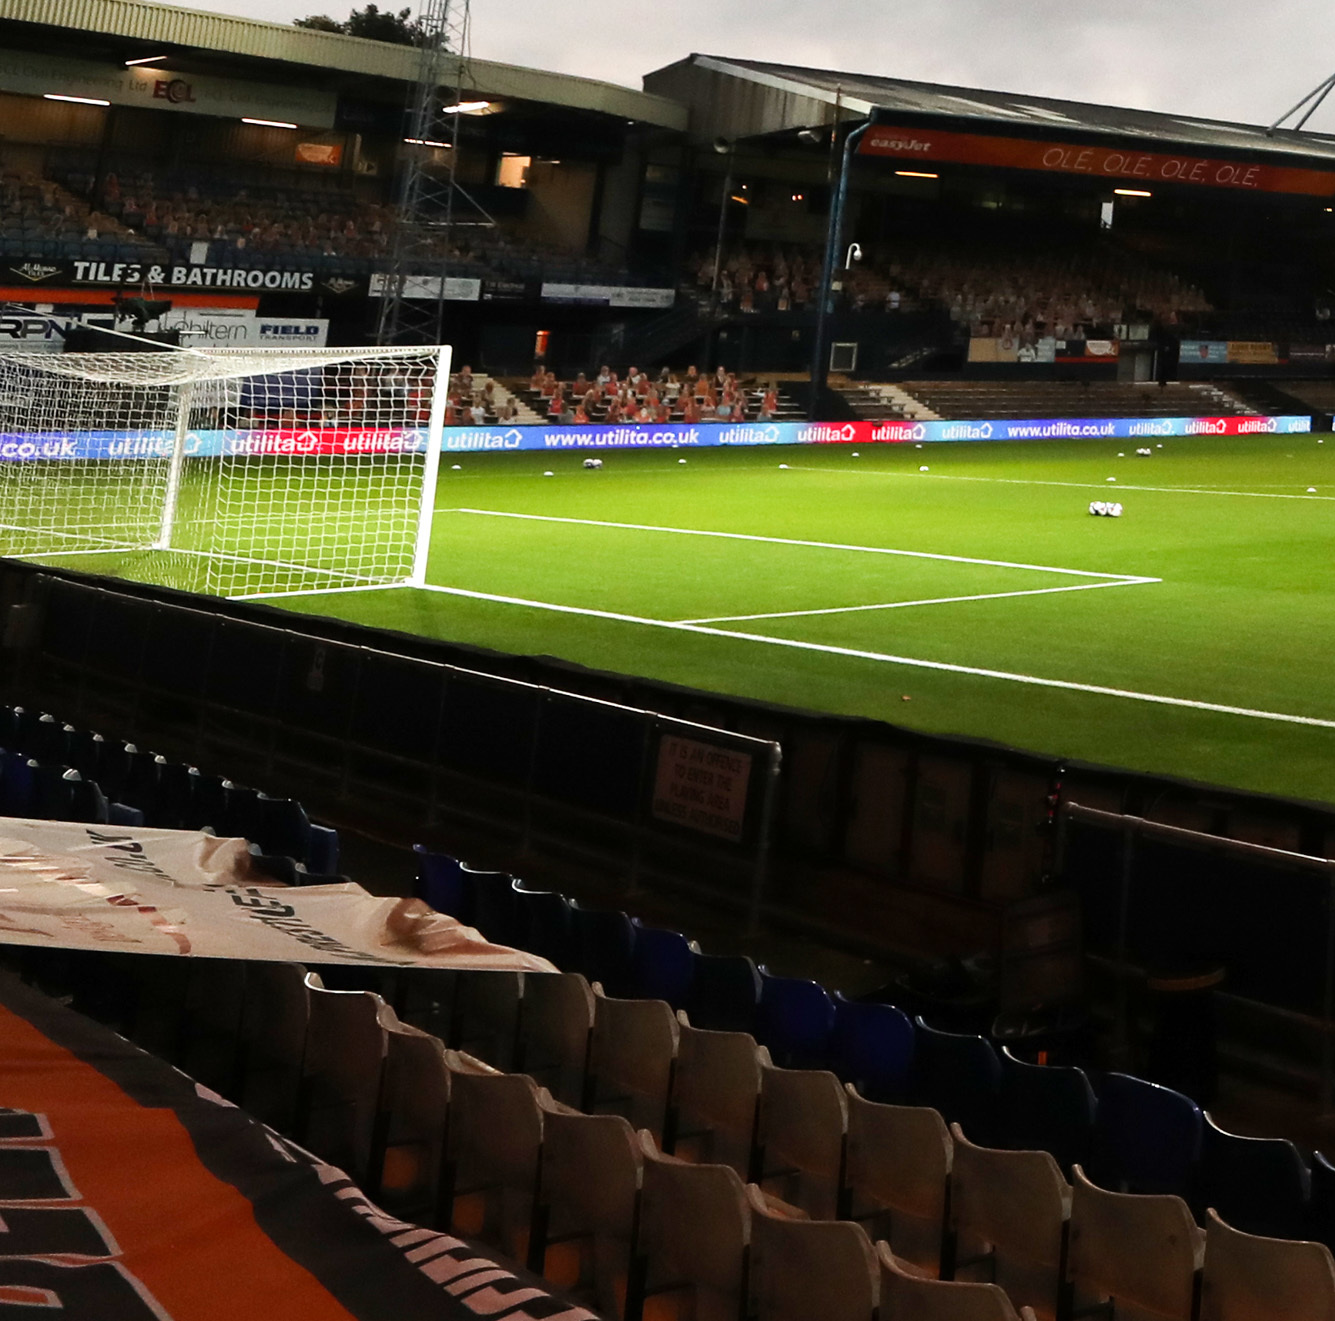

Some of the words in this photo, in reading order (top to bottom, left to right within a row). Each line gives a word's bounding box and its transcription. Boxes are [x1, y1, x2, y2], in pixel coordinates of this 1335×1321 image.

[869, 136, 932, 153] easyJet
[73, 260, 141, 283] TILES
[146, 264, 164, 284] &
[171, 266, 314, 290] BATHROOMS
[176, 319, 247, 341] Chiltern
[260, 325, 319, 336] FIELD
[719, 425, 765, 444] utilita
[797, 423, 843, 442] utilita
[871, 422, 913, 441] utilita
[942, 421, 981, 440] utilita
[1007, 417, 1115, 438] www.utilita.co.uk
[1129, 418, 1165, 437] utilita
[1185, 417, 1217, 435] utilita
[1237, 416, 1269, 434] utilita
[231, 431, 295, 454] utilita
[343, 429, 403, 453] utilita
[447, 429, 504, 449] utilita
[543, 426, 700, 447] www.utilita.co.uk
[705, 750, 742, 774] OFFENCE
[674, 762, 687, 779] TO
[687, 766, 715, 785] ENTER
[717, 773, 733, 792] THE
[706, 793, 730, 811] AREA
